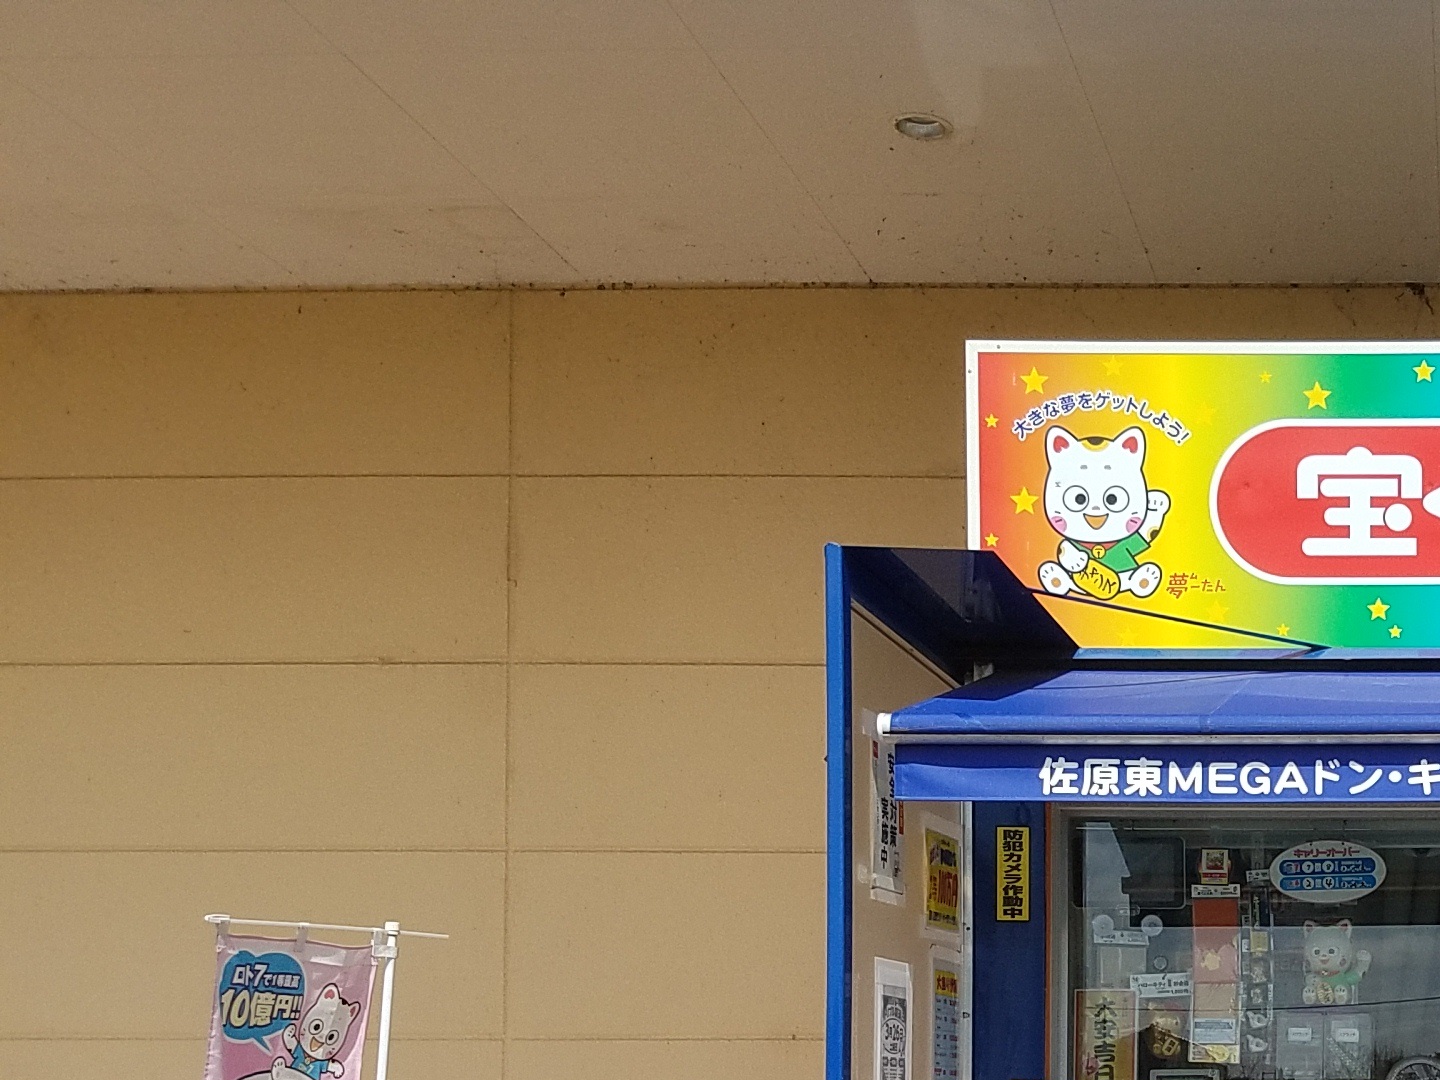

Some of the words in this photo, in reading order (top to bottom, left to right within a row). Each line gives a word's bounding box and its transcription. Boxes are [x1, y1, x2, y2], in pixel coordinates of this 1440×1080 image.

[1002, 828, 1025, 918] 防犯カメラ作動中
[221, 988, 304, 1027] 10億円!!
